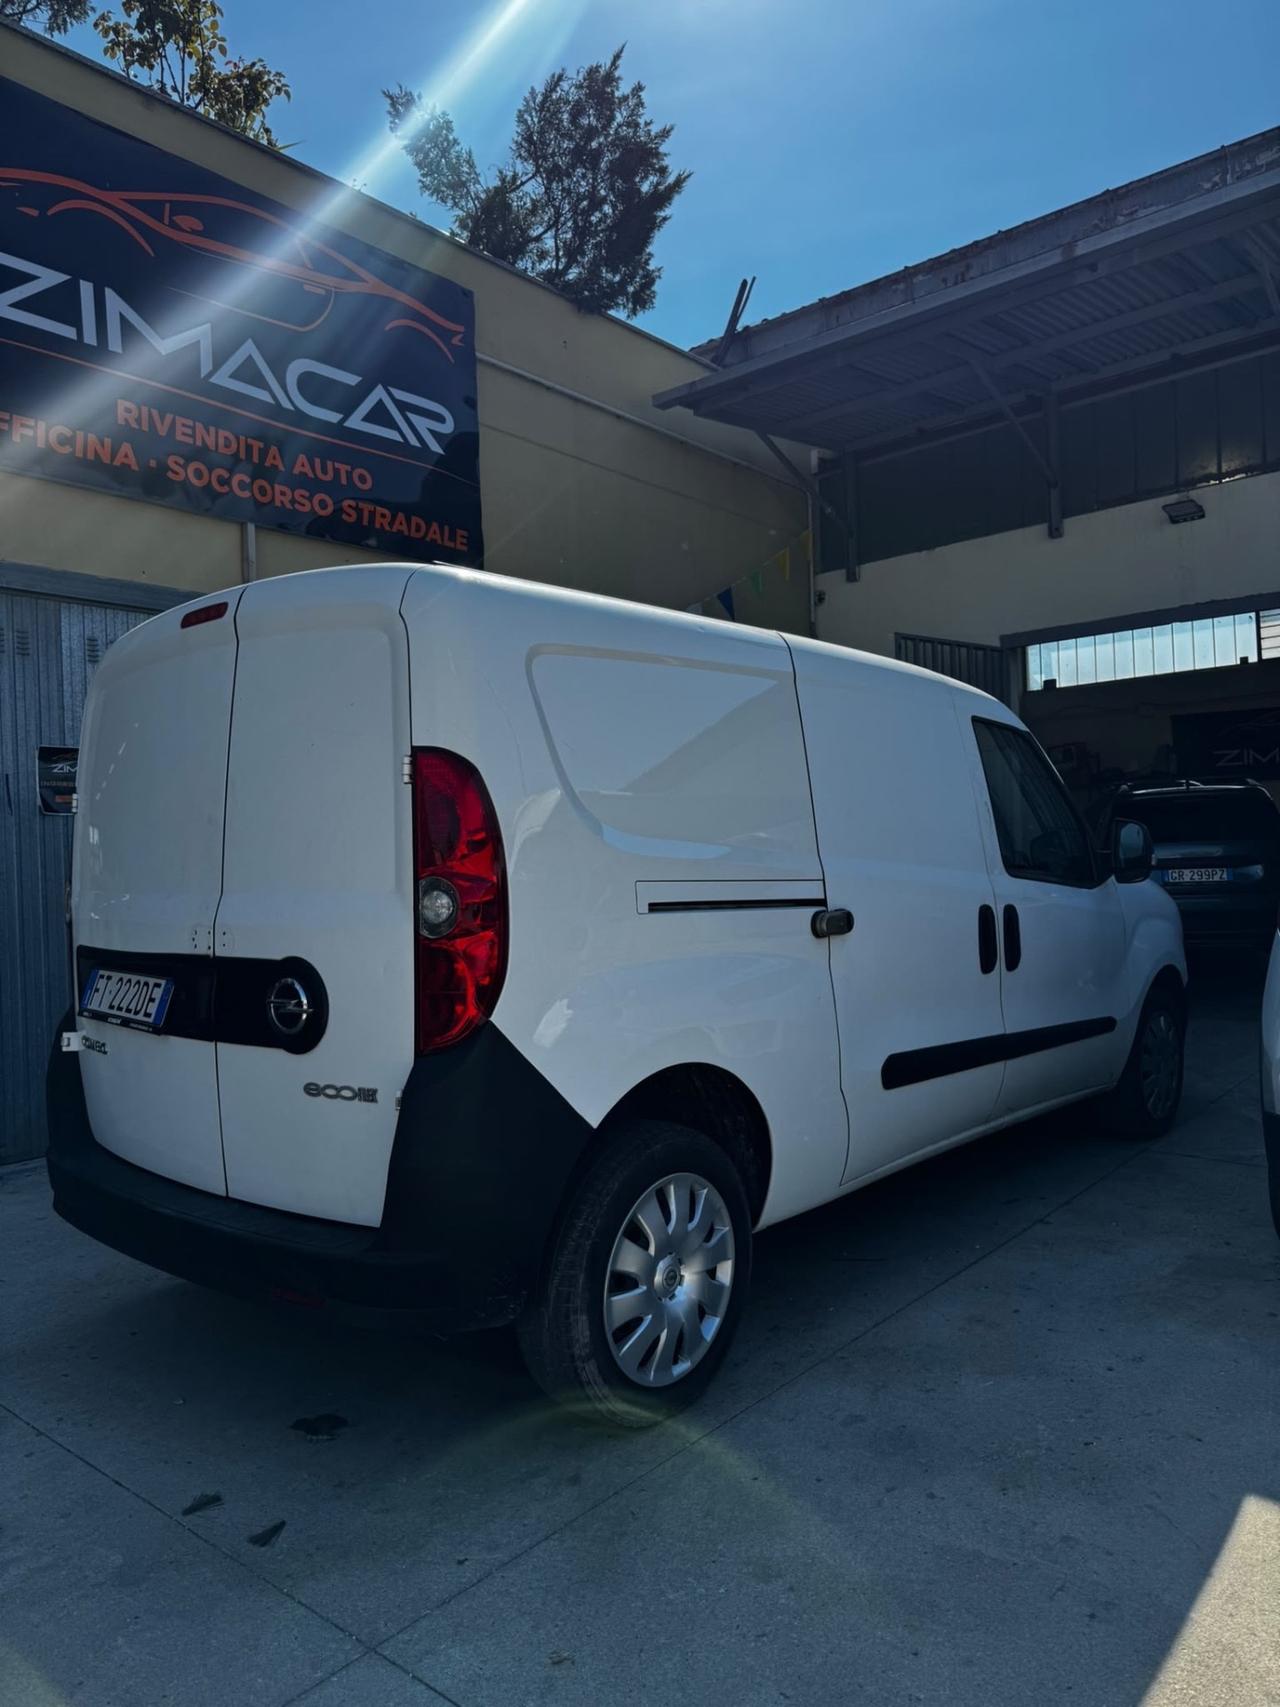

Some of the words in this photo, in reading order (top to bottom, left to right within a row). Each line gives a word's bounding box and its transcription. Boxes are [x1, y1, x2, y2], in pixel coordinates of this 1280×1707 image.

[0, 251, 455, 455] ZIMACAR
[116, 400, 284, 471] RIVENDITA
[293, 450, 373, 490] AUTO
[166, 453, 335, 517] SOCCORSO
[342, 501, 469, 552] STRADALE
